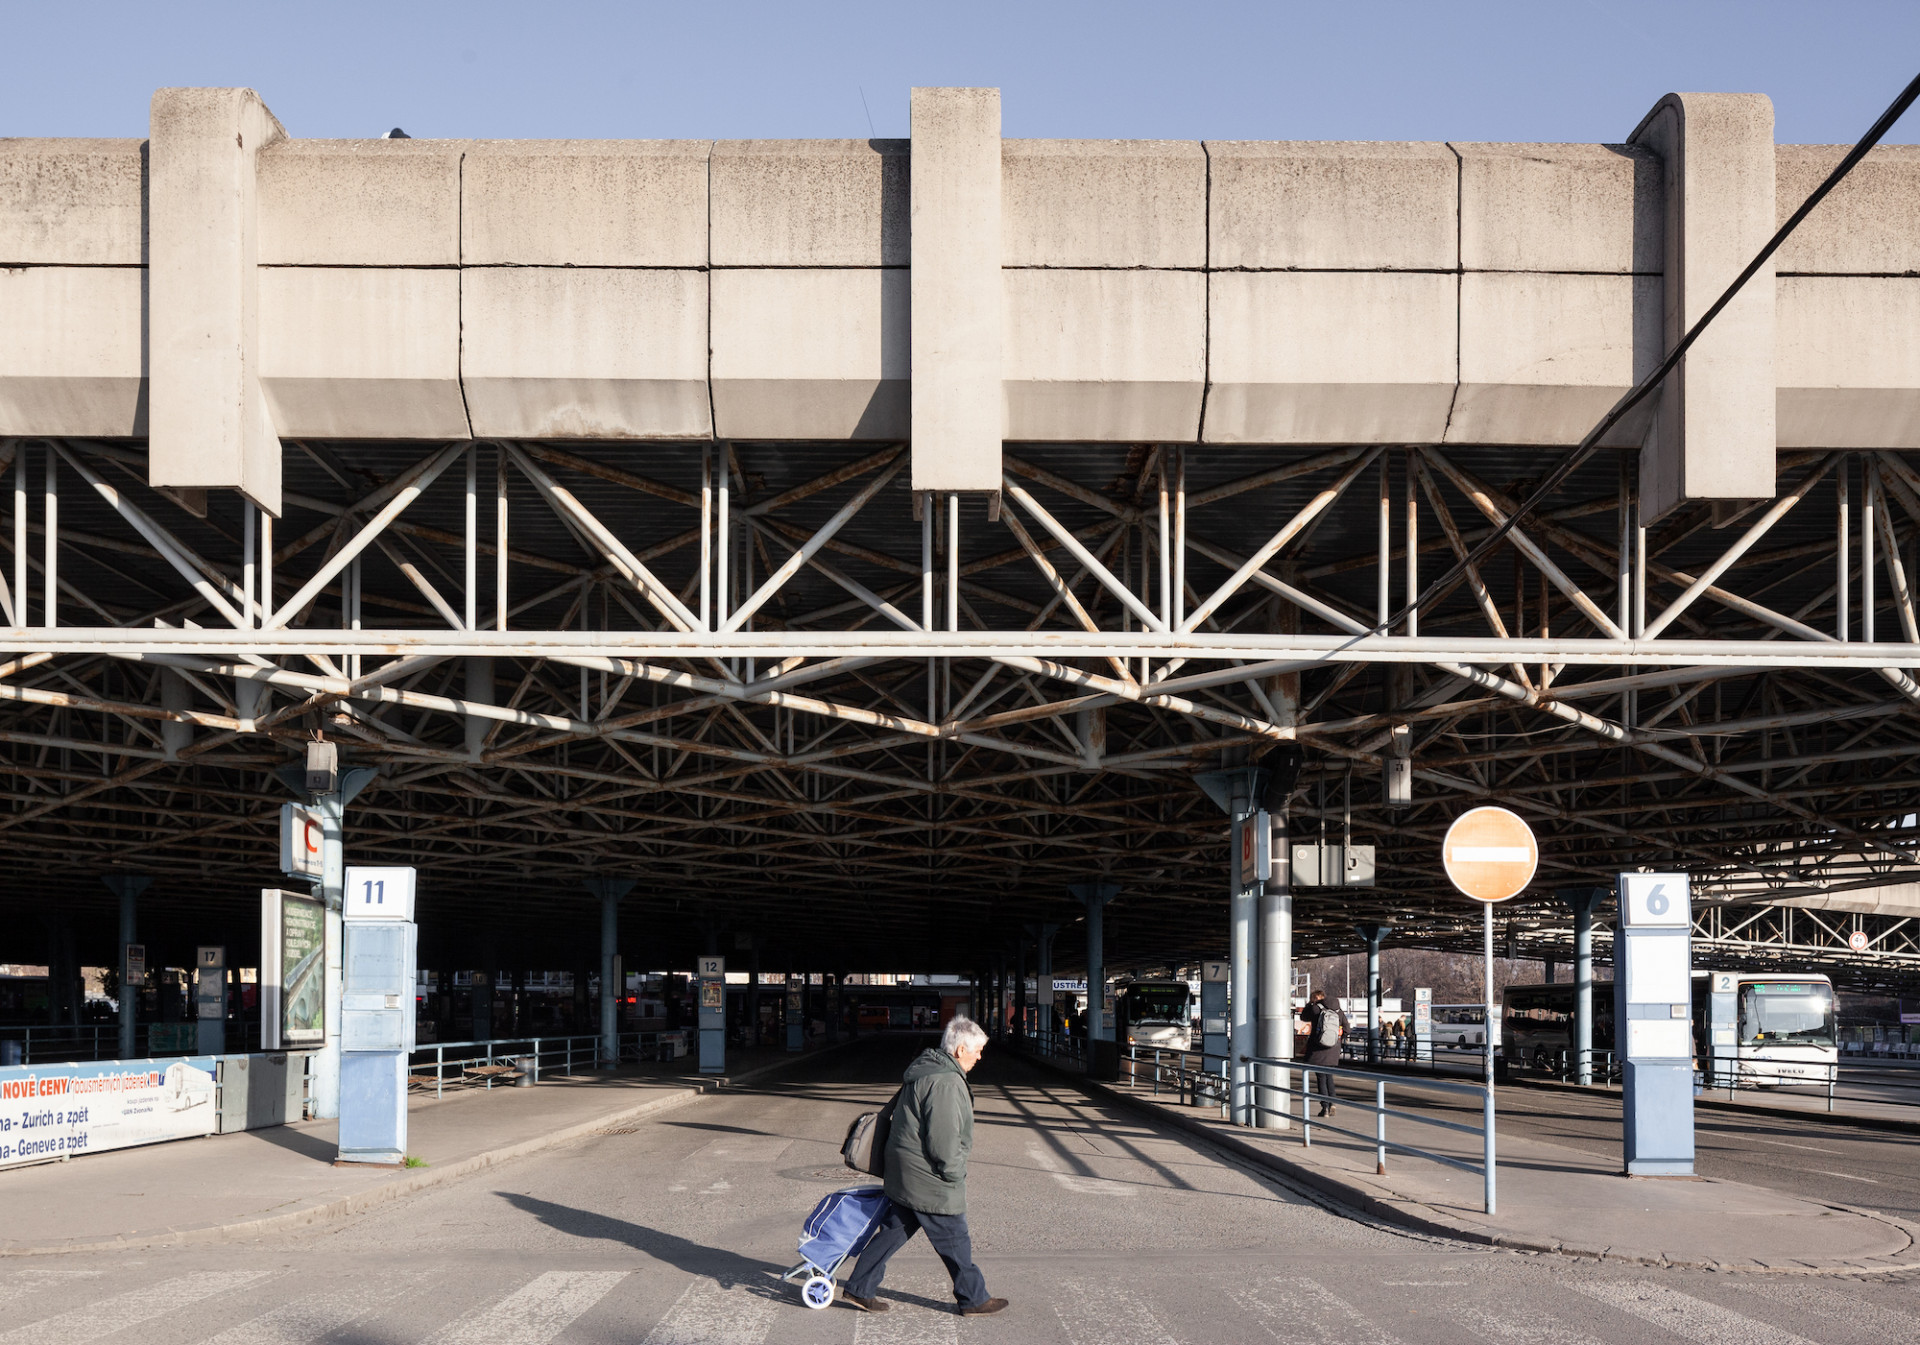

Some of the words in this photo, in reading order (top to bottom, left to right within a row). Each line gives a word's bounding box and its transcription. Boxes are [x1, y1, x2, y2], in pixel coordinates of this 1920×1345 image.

[304, 819, 318, 853] C
[1244, 826, 1250, 860] B
[362, 880, 384, 904] 11
[1646, 884, 1670, 915] 6
[205, 952, 216, 961] 17
[705, 962, 717, 972] 12
[1211, 965, 1219, 977] 7
[1722, 977, 1730, 989] 2
[3, 1075, 36, 1099] NOVÉ
[39, 1078, 68, 1096] CENY
[22, 1109, 54, 1129] Zurich
[57, 1112, 63, 1125] a
[67, 1106, 88, 1128] zpět
[18, 1139, 56, 1156] Geneve
[58, 1137, 64, 1150] a
[67, 1131, 87, 1153] zpět
